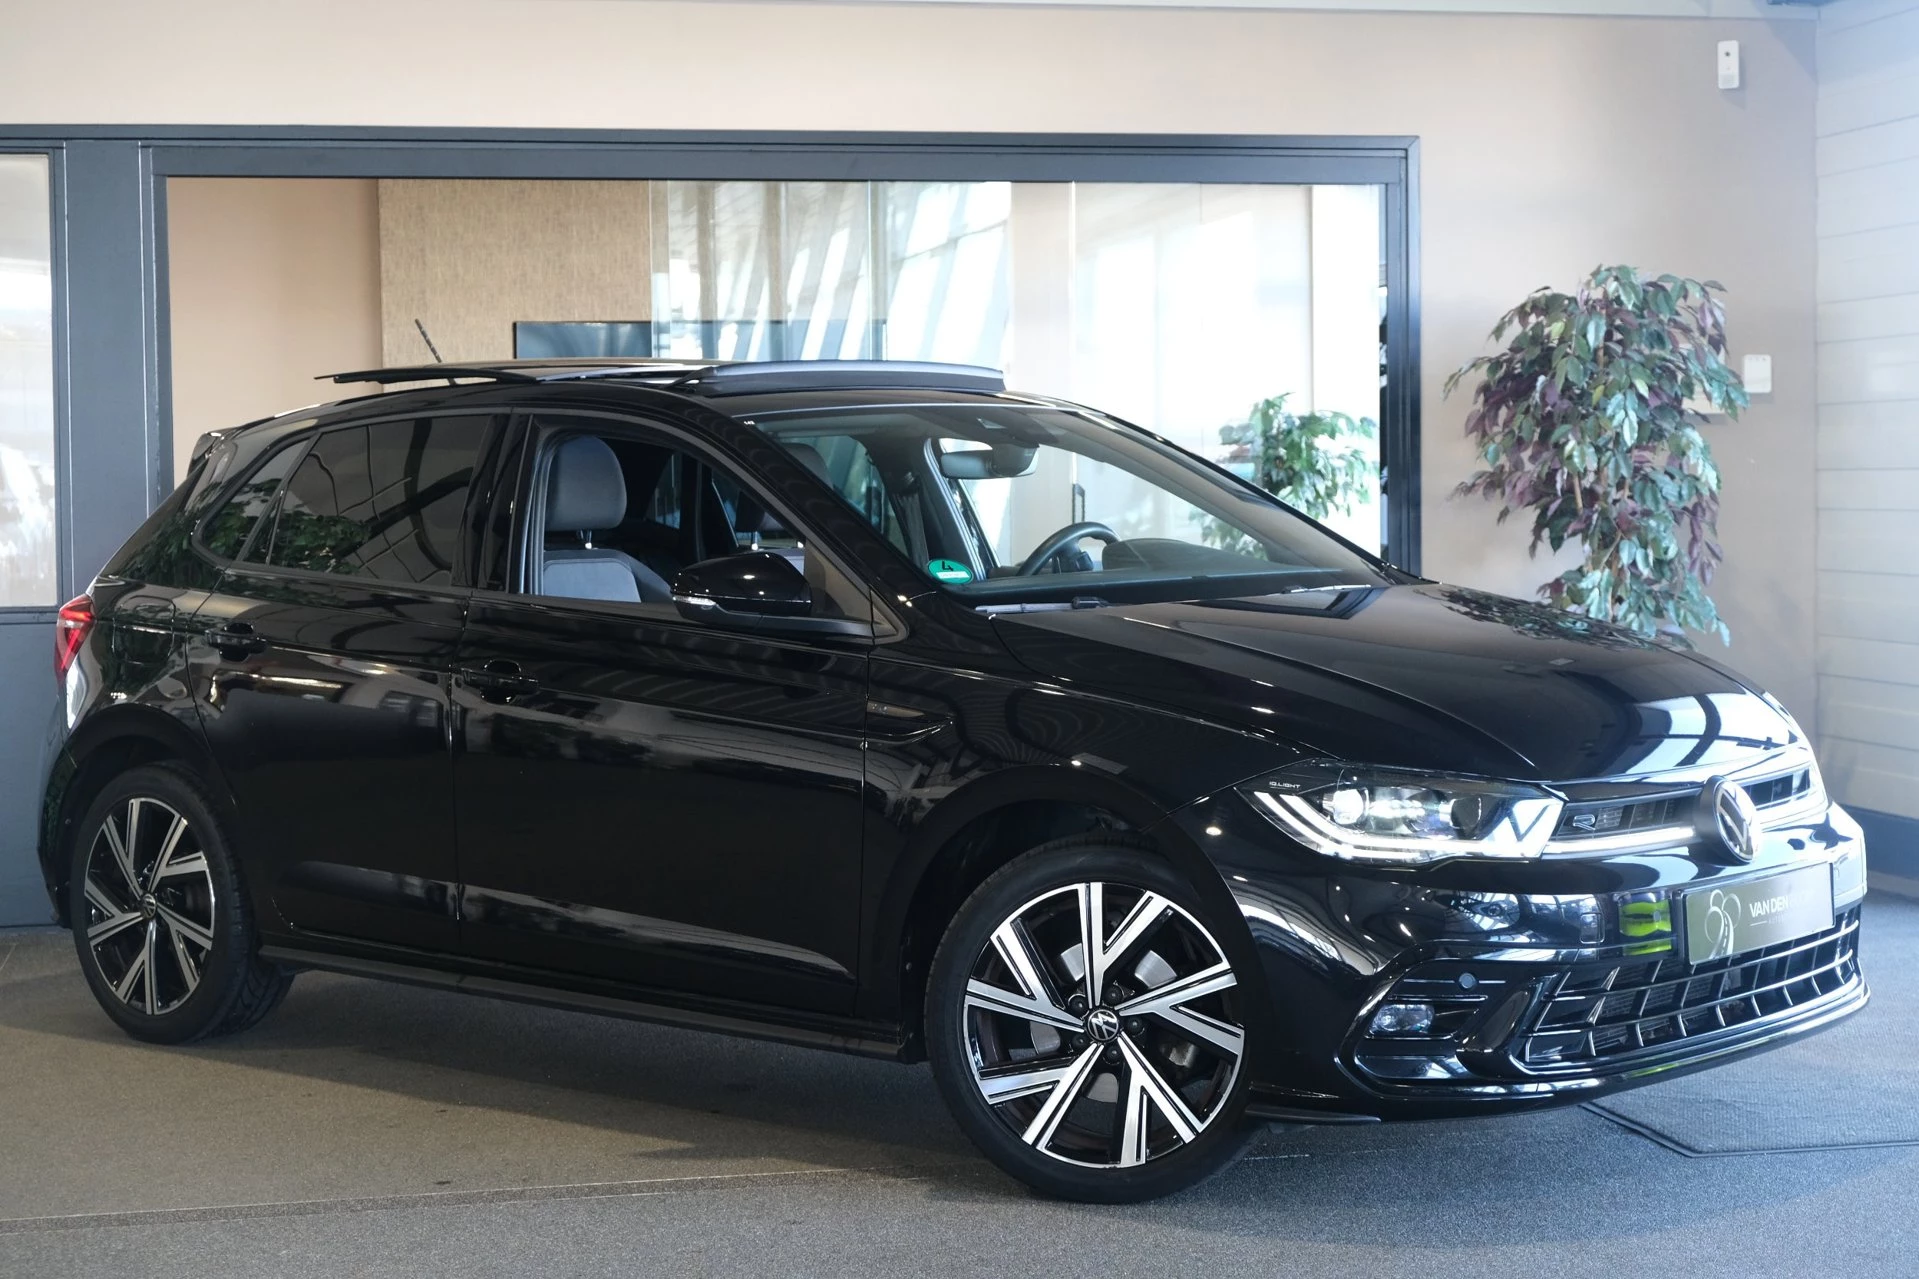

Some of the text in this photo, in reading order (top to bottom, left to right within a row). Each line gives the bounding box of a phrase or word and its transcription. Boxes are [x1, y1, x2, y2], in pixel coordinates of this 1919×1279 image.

[941, 560, 954, 571] 4
[1269, 781, 1301, 789] IQ.LIGHT
[1749, 899, 1770, 918] VAN
